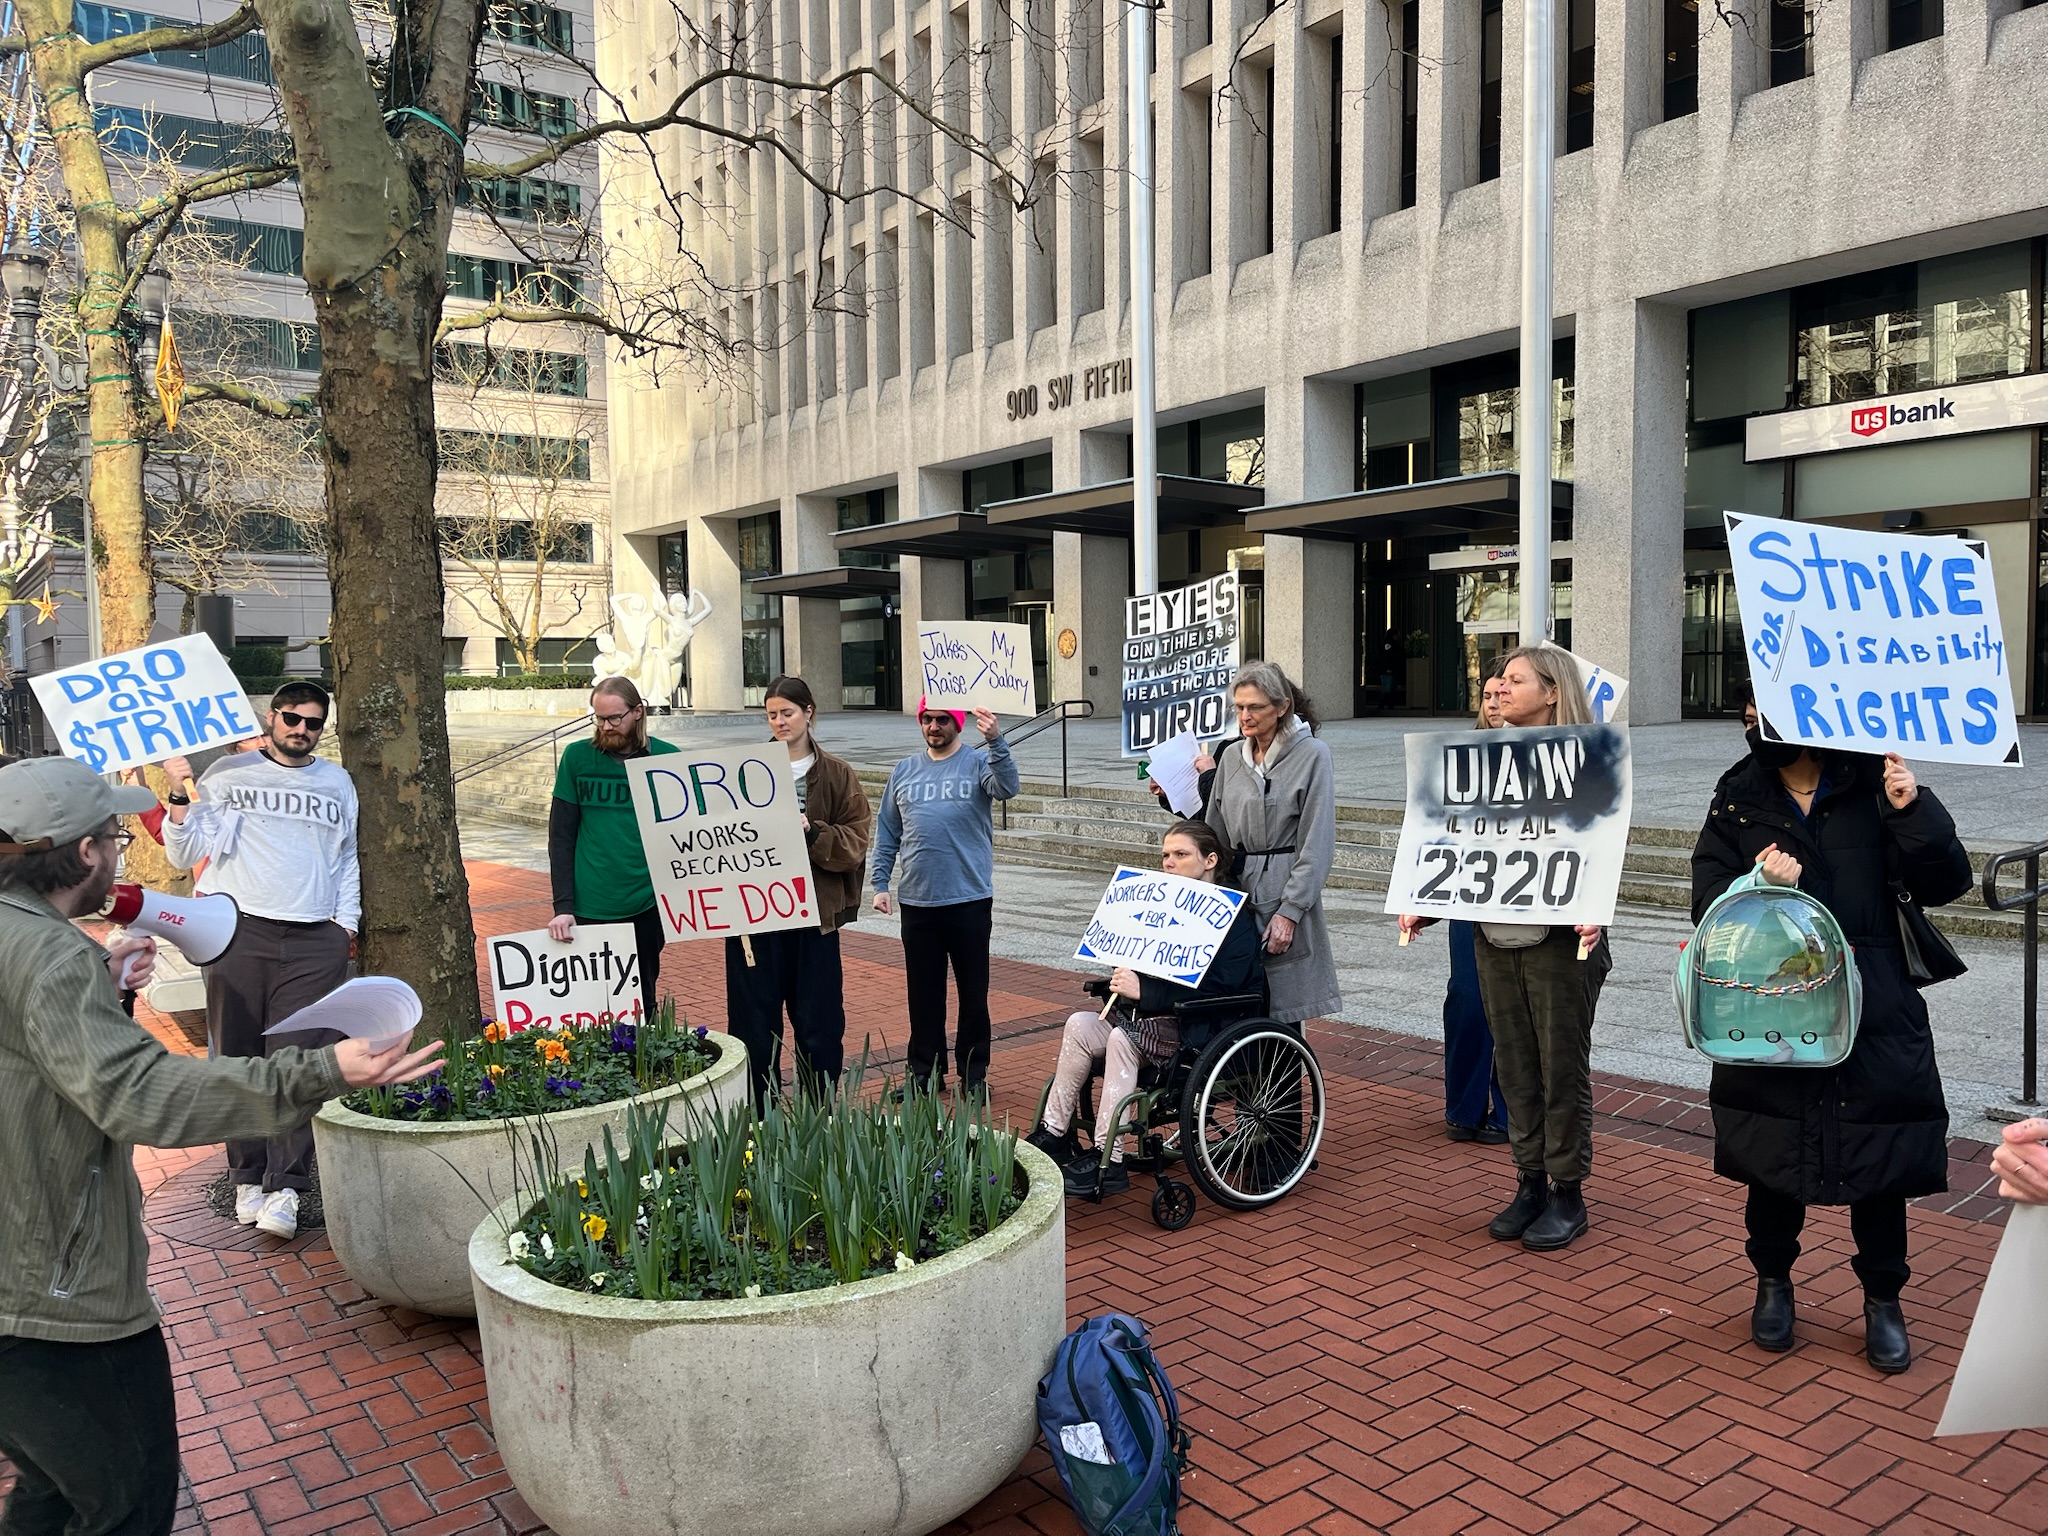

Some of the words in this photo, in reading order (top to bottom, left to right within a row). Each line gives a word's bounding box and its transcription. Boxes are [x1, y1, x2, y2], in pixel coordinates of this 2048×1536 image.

[1006, 384, 1038, 422] 900
[1048, 374, 1073, 411] SW
[1083, 357, 1132, 401] FIFTH
[1131, 575, 1235, 637] EYES
[992, 630, 1015, 670] My
[1128, 657, 1188, 681] HANDS
[1195, 647, 1230, 666] OFF
[1129, 642, 1154, 659] ON
[1162, 632, 1199, 653] THE
[1751, 611, 1784, 670] FOR
[56, 649, 186, 704] DRO
[108, 683, 176, 713] ON
[924, 662, 968, 695] Raise
[989, 660, 1029, 705] Salary
[69, 691, 254, 774] $TRIKE
[1133, 695, 1223, 747] DRO
[645, 759, 776, 823] DRO
[1447, 739, 1576, 803] UAW
[670, 821, 759, 854] WORKS
[1447, 815, 1557, 836] LOCAL
[670, 847, 782, 880] BECAUSE
[1417, 849, 1581, 906] 2320
[158, 911, 186, 926] PYLE
[660, 887, 731, 935] WE
[738, 876, 809, 924] DO!
[1105, 882, 1169, 905] WORKERS
[1174, 887, 1233, 930] UNITED
[1145, 911, 1167, 929] FOR
[1086, 919, 1155, 960] DISABILITY
[1153, 941, 1215, 970] RIGHTS
[493, 941, 640, 998] Dignity,
